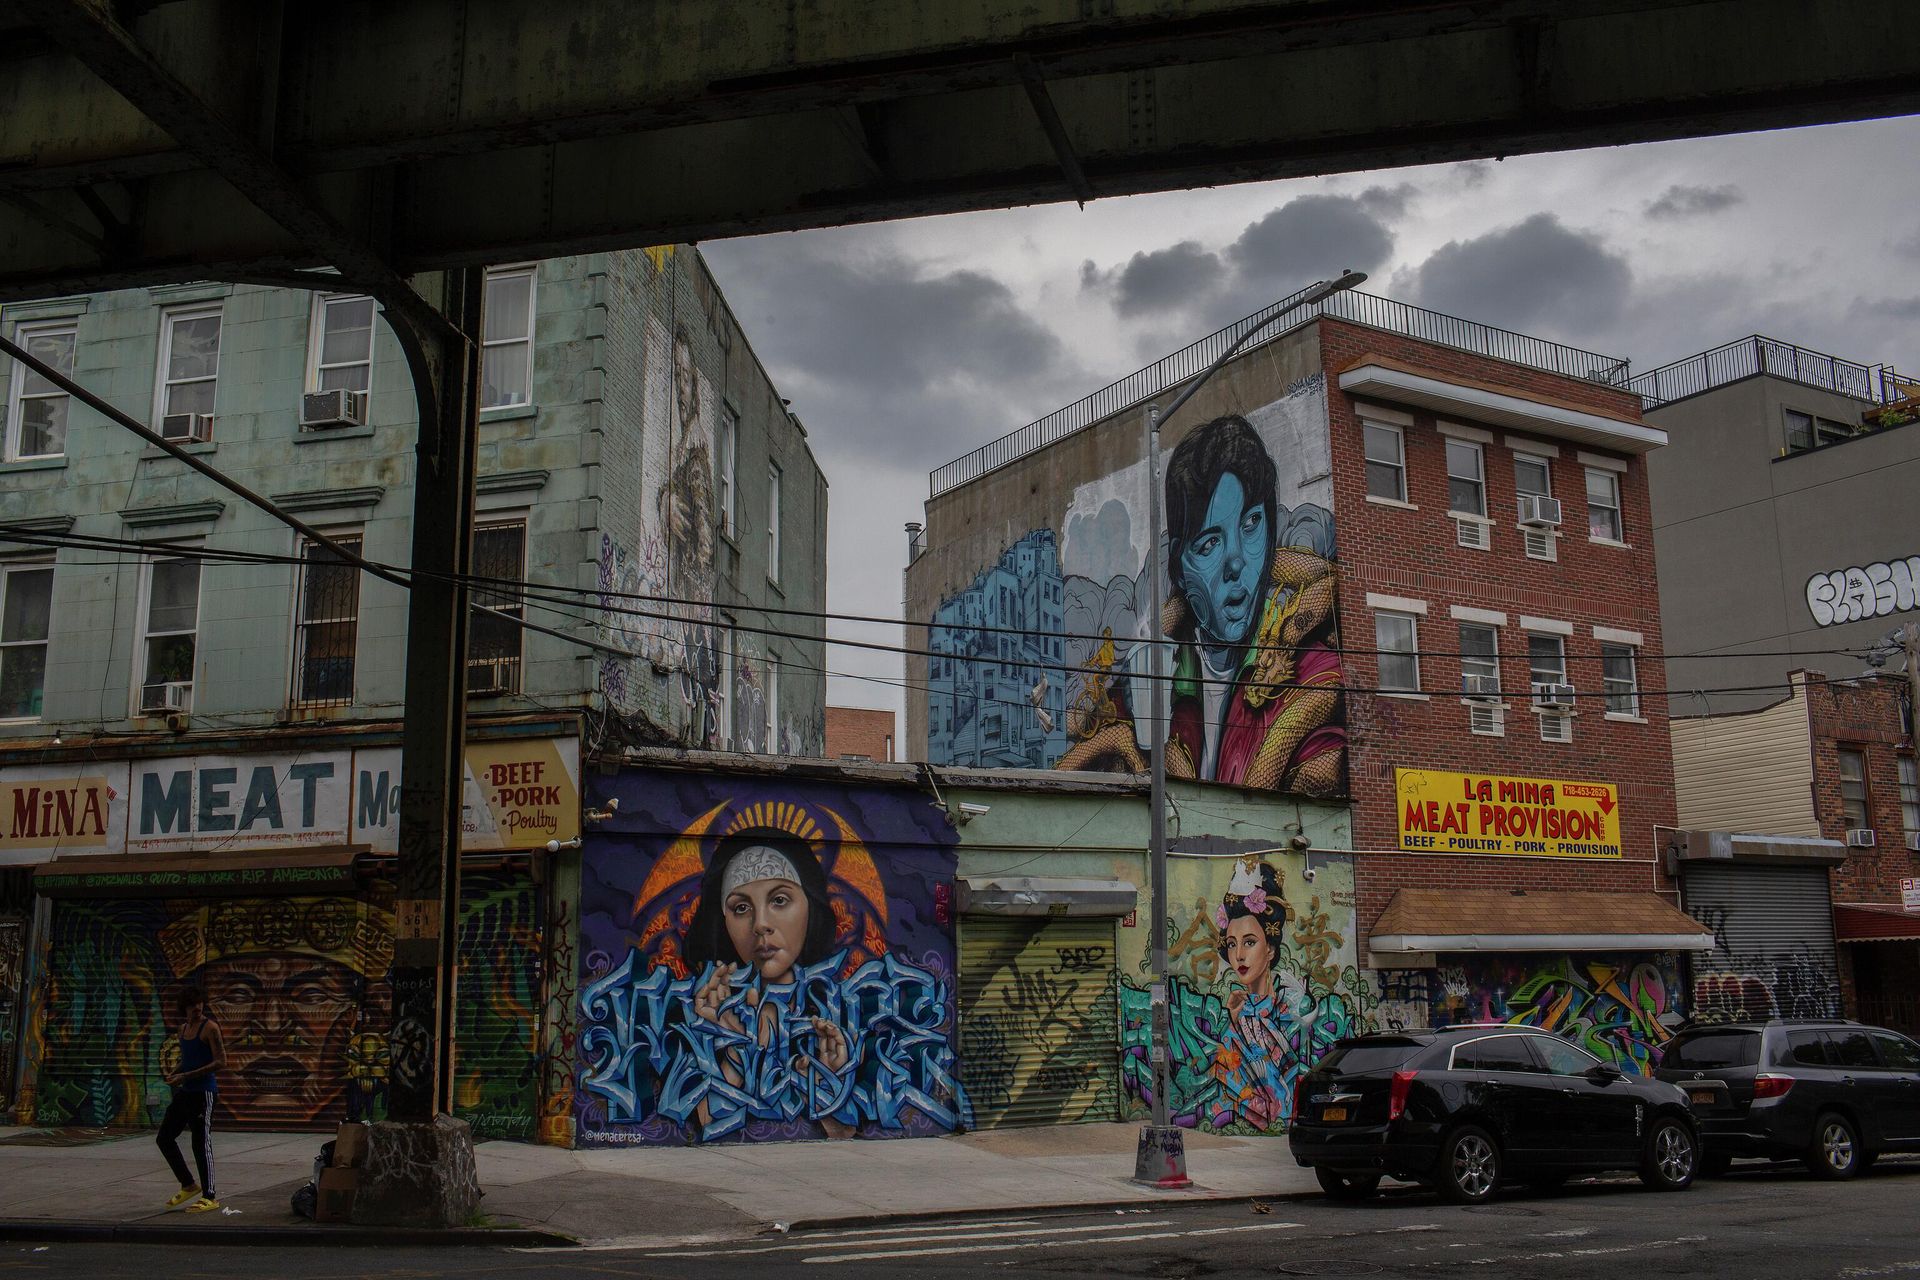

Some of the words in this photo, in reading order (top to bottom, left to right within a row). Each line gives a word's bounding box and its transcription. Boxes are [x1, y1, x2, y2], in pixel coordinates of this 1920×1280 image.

[489, 761, 545, 786] BEEF
[140, 762, 334, 835] MEAT
[498, 786, 560, 807] PORK
[1463, 778, 1492, 802] LA
[1498, 781, 1555, 807] MINA
[1563, 784, 1607, 798] 718-453-2626
[506, 809, 558, 835] Poultry
[1404, 799, 1470, 835] MEAT
[1479, 804, 1600, 841] PROVISION
[1404, 835, 1436, 848] BEEF
[1449, 838, 1502, 851] POULTRY
[1514, 841, 1546, 853] PORK
[1557, 843, 1619, 856] PROVISION
[149, 873, 181, 887] QUITO
